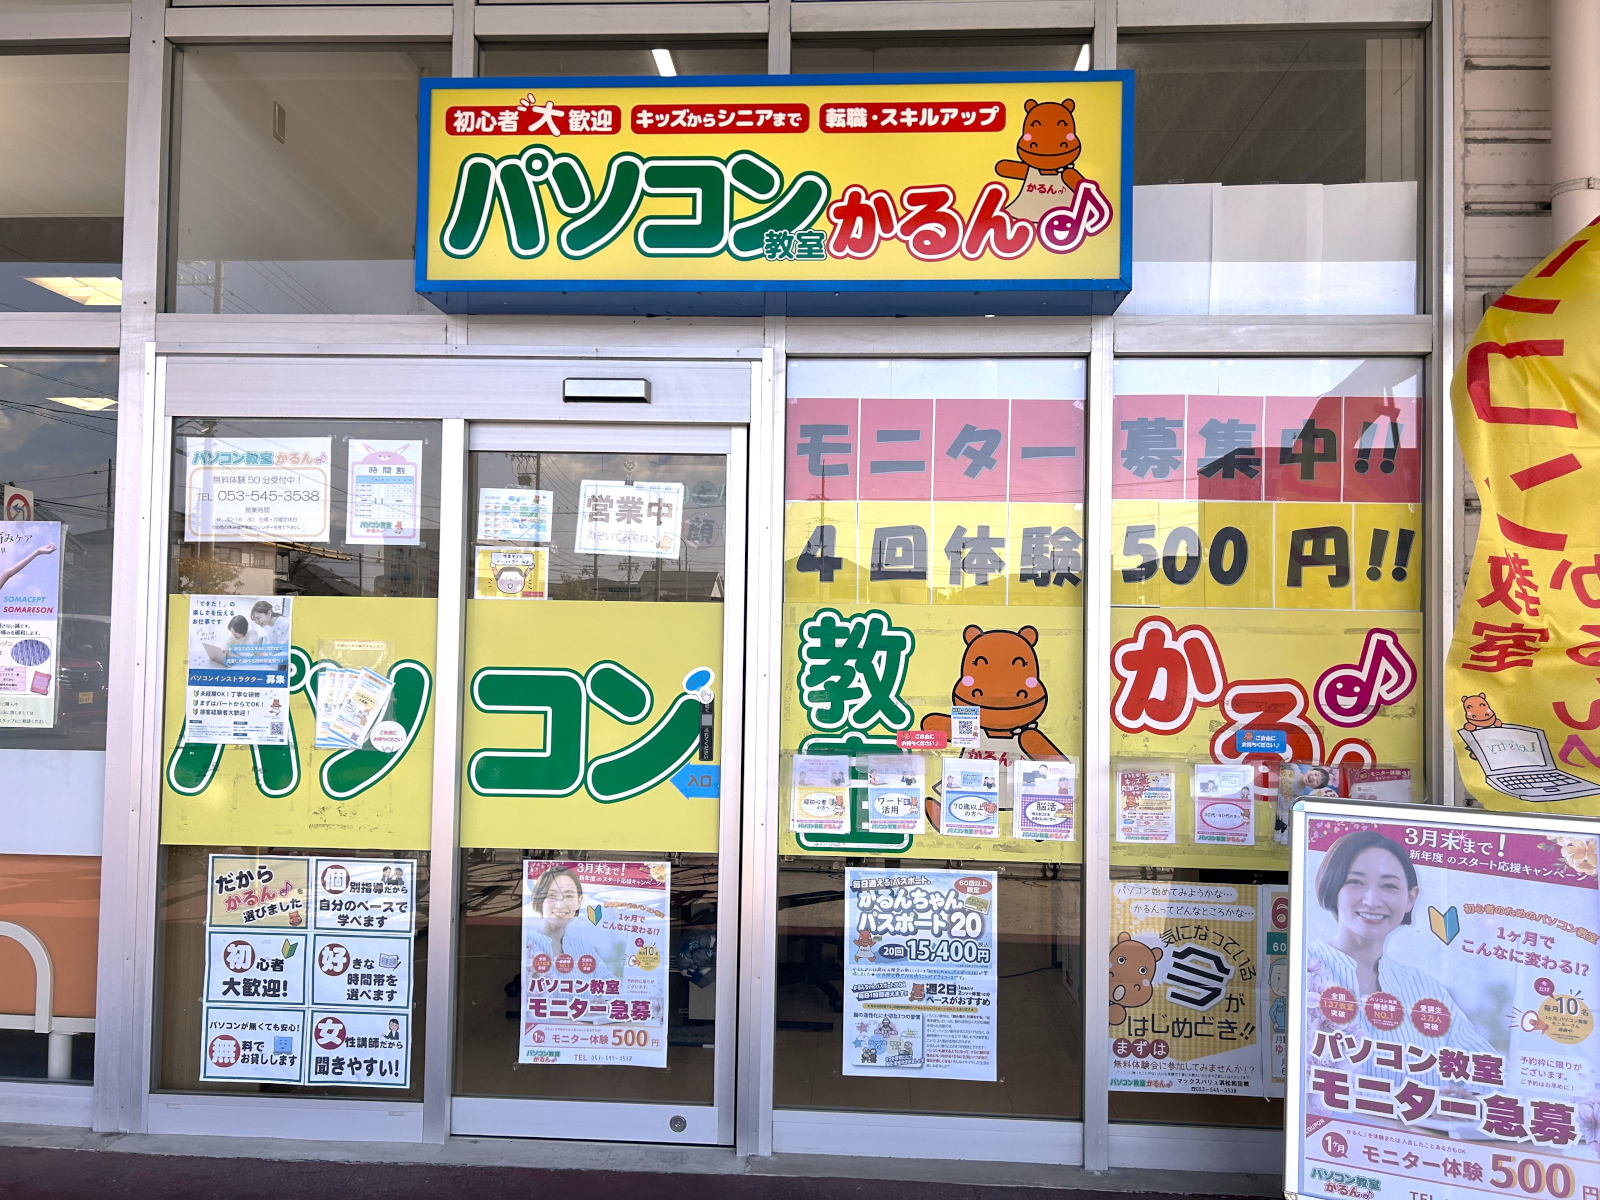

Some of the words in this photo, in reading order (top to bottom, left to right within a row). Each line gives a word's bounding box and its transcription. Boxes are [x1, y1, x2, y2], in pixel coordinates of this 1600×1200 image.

[635, 109, 802, 129] キッズからシニアまで
[825, 106, 1000, 128] 転職・スキルアップ
[440, 144, 829, 262] パソコン
[764, 229, 827, 262] 教室
[826, 182, 1035, 262] かるん
[192, 450, 275, 466] パソコン教室
[275, 452, 314, 466] かるん
[197, 492, 213, 502] TEL
[217, 490, 320, 502] 053-545-3538
[245, 506, 271, 514] 営業時間
[586, 494, 674, 527] 営業中
[3, 606, 54, 614] SOMARESON
[192, 609, 235, 617] 楽しさを伝える
[192, 618, 223, 626] お仕事です
[190, 674, 263, 683] パソコンインストラクター
[265, 674, 286, 685] 募集
[687, 774, 712, 788] 入口
[877, 797, 904, 806] ワード
[953, 802, 985, 812] 70歳以上
[1036, 801, 1058, 812] 脳活
[881, 805, 899, 815] 活用
[215, 865, 274, 895] だから
[223, 886, 276, 912] かるん
[319, 899, 409, 913] 自分のペースで
[857, 887, 964, 912] かるんちゃん
[242, 897, 304, 924] 選びました
[337, 914, 388, 928] 学べます
[1463, 903, 1600, 945] 初心者のためのパソコン教室
[225, 943, 285, 972] 初心者
[346, 973, 399, 987] 時間帯を
[529, 978, 620, 995] パソコン教室
[221, 977, 288, 998] 大歓迎!
[925, 983, 957, 996] 週2日
[346, 989, 398, 1001] 選べます
[926, 996, 991, 1006] ペースがおすすめ
[1331, 993, 1346, 1001] 全国
[528, 997, 652, 1021] モニター急募
[1323, 1000, 1354, 1011] 137教室
[1372, 1002, 1396, 1012] 継続率
[1420, 1004, 1443, 1014] 受講生
[1330, 1009, 1346, 1018] 突破
[1420, 1014, 1443, 1023] 3万人
[1423, 1022, 1440, 1031] 突破
[552, 1034, 609, 1045] モニター体験
[1116, 1037, 1166, 1056] まずは
[240, 1053, 298, 1067] お貸しします
[526, 1050, 561, 1058] パソコン教室
[573, 1054, 588, 1062] TEL
[1311, 1031, 1505, 1087] パソコン教室
[314, 1056, 400, 1077] 聞きやすい!
[1520, 1055, 1583, 1071] 予約枠に限りが
[1520, 1067, 1568, 1081] ございます。
[1110, 1078, 1146, 1087] パソコン教室
[1311, 1069, 1578, 1145] モニター急募
[1362, 1144, 1483, 1182] モニター体験
[1310, 1166, 1382, 1192] パソコン教室
[1324, 1182, 1361, 1198] かるん
